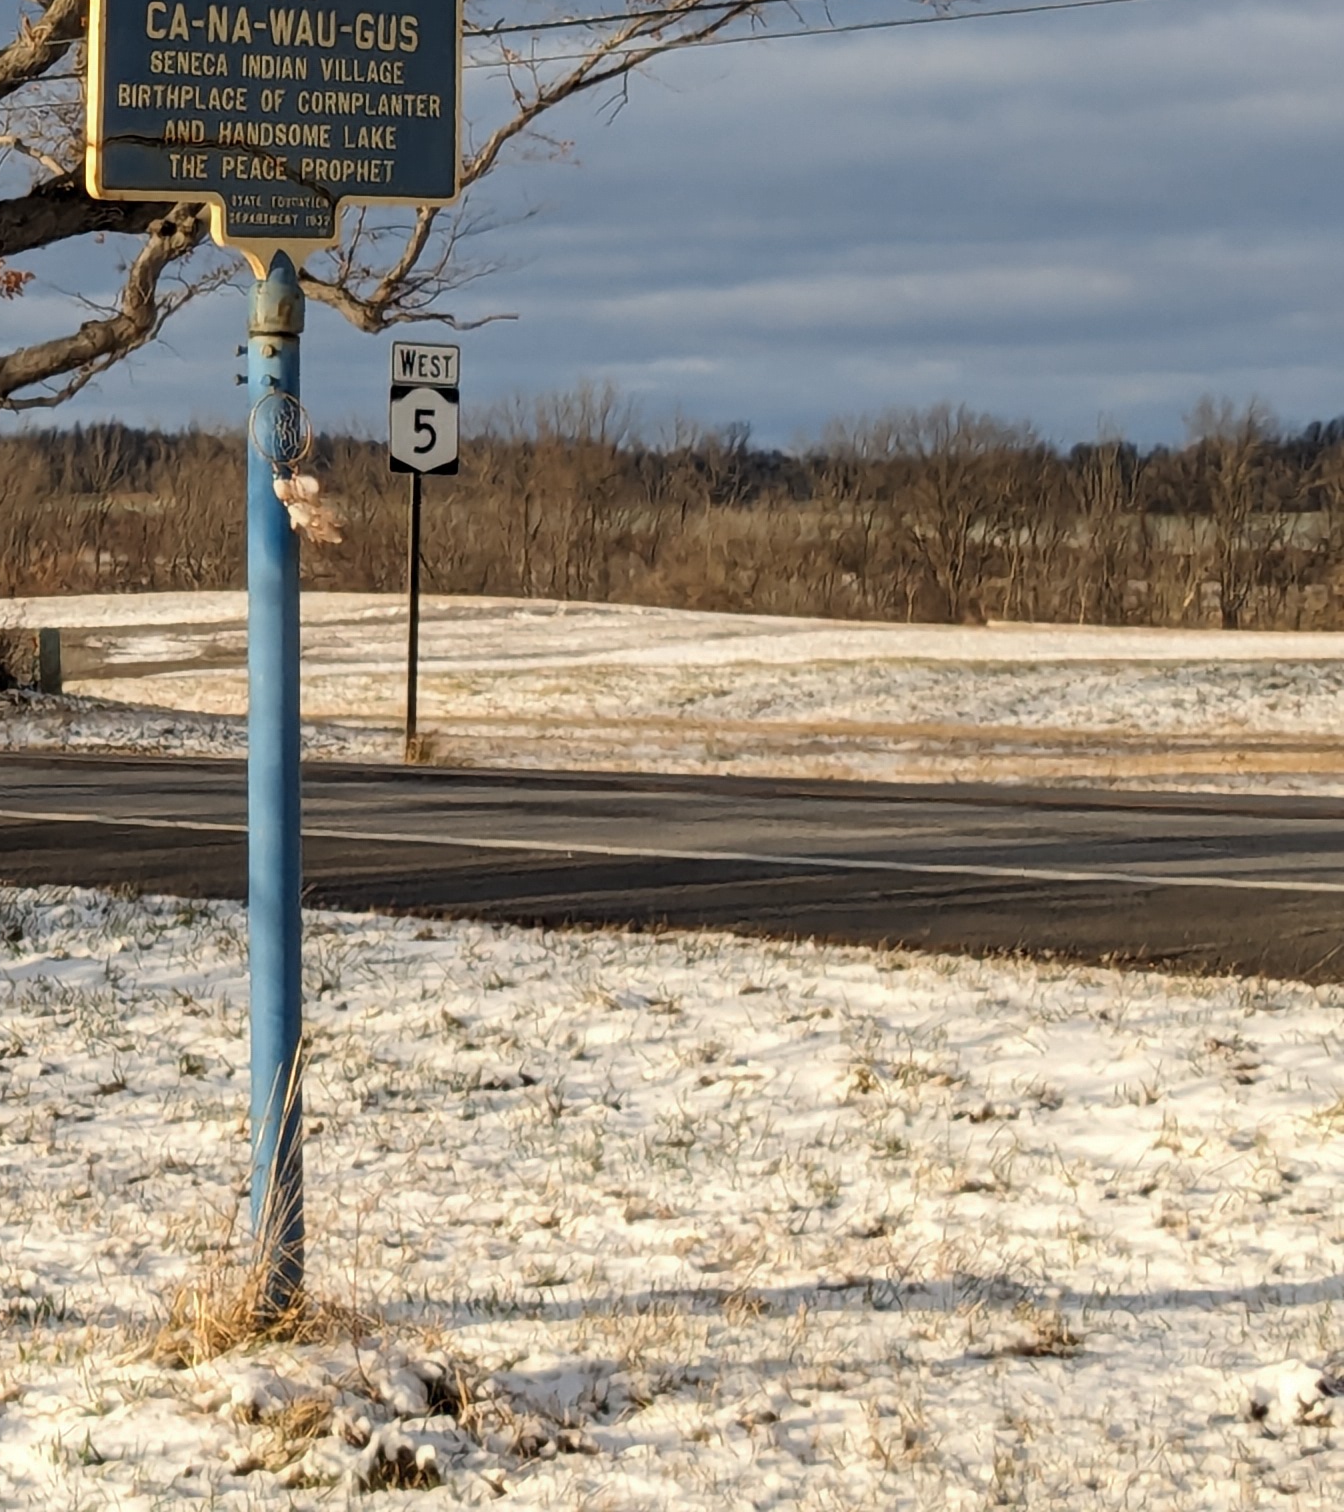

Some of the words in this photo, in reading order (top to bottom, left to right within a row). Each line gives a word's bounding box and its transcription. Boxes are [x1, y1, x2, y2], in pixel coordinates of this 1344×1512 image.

[146, 1, 418, 52] CA-NA-WAU-GUS
[150, 50, 228, 76] SENECA
[242, 53, 307, 79] INDIAN
[320, 57, 405, 84] VILLAGE
[118, 83, 247, 111] BIRTHPLACE
[260, 89, 286, 113] OF
[298, 91, 441, 118] CORNPLANTER
[165, 120, 205, 143] AND
[218, 121, 332, 149] HANDSOME
[344, 125, 397, 150] LAKE
[169, 154, 208, 178] THE
[222, 155, 288, 181] PEACE
[301, 158, 395, 183] PROPHET
[400, 349, 453, 378] WEST
[413, 408, 437, 454] 5
